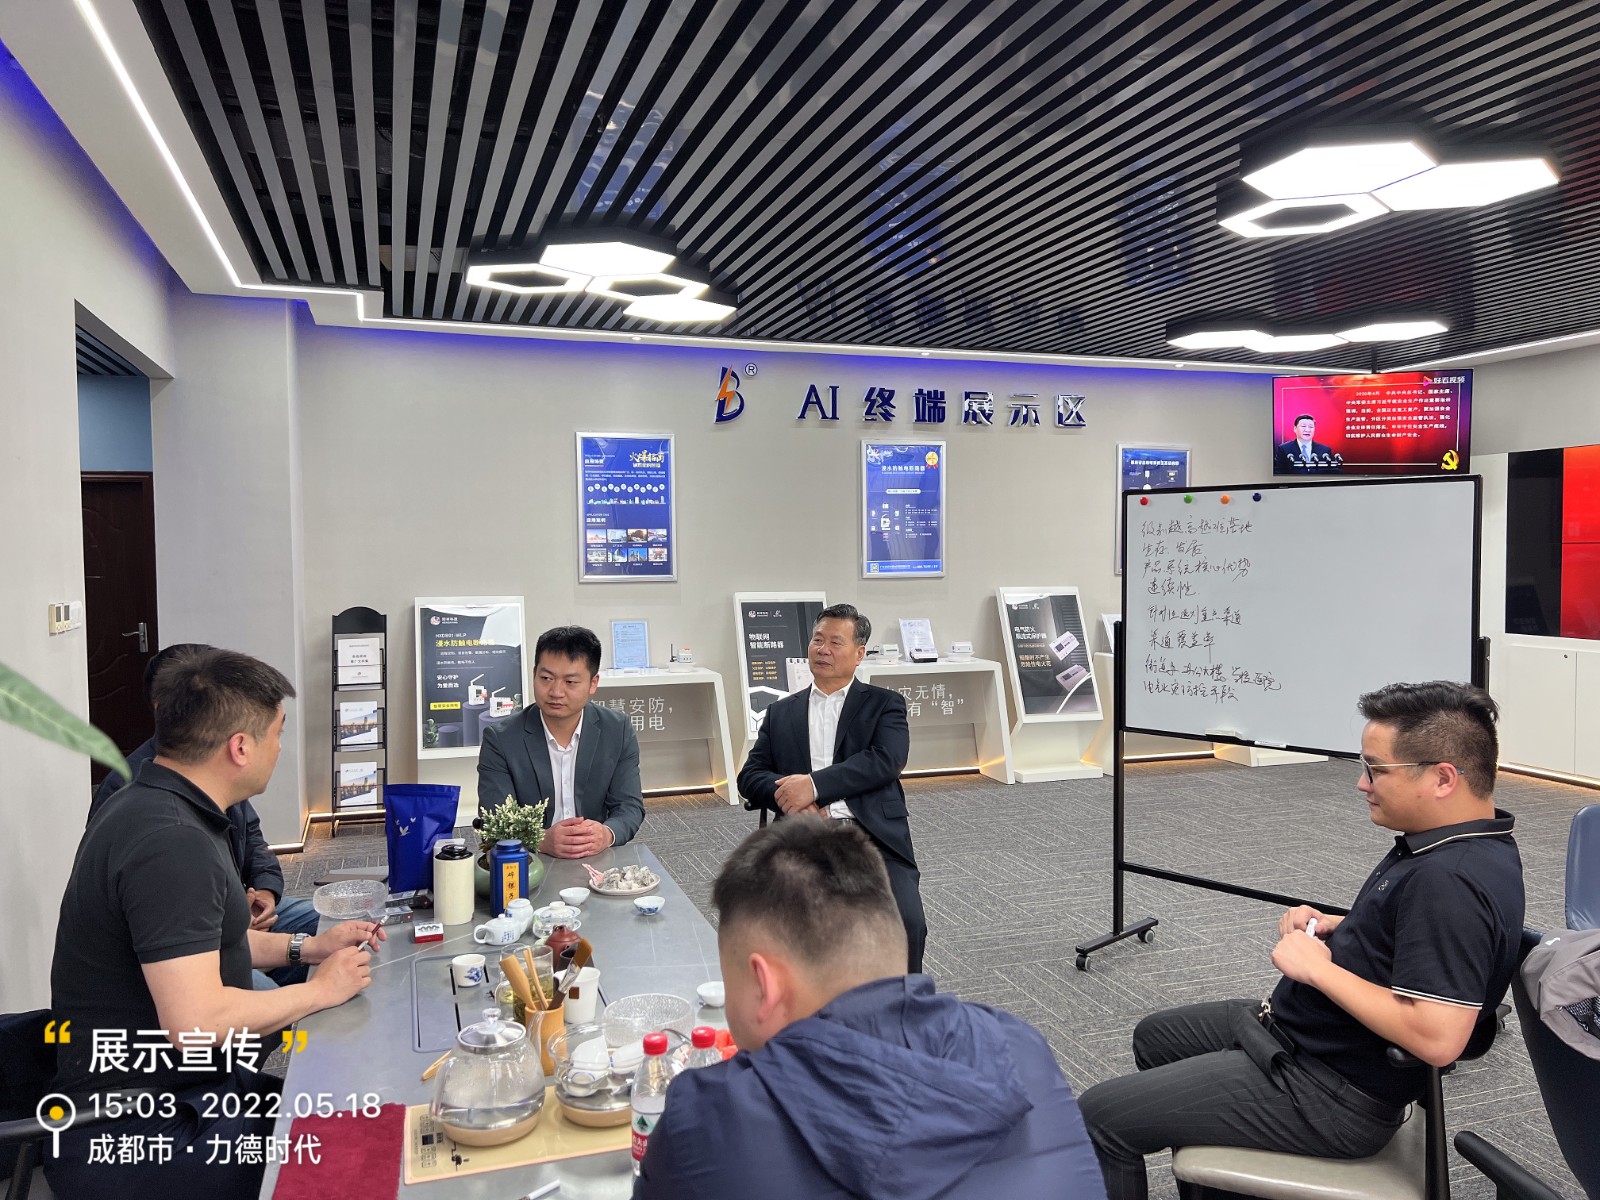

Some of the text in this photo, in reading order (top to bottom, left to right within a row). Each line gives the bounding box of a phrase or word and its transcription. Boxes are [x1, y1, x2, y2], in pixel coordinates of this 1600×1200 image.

[796, 384, 1087, 428] AI 终端展示区
[886, 683, 953, 700] 灾无情，
